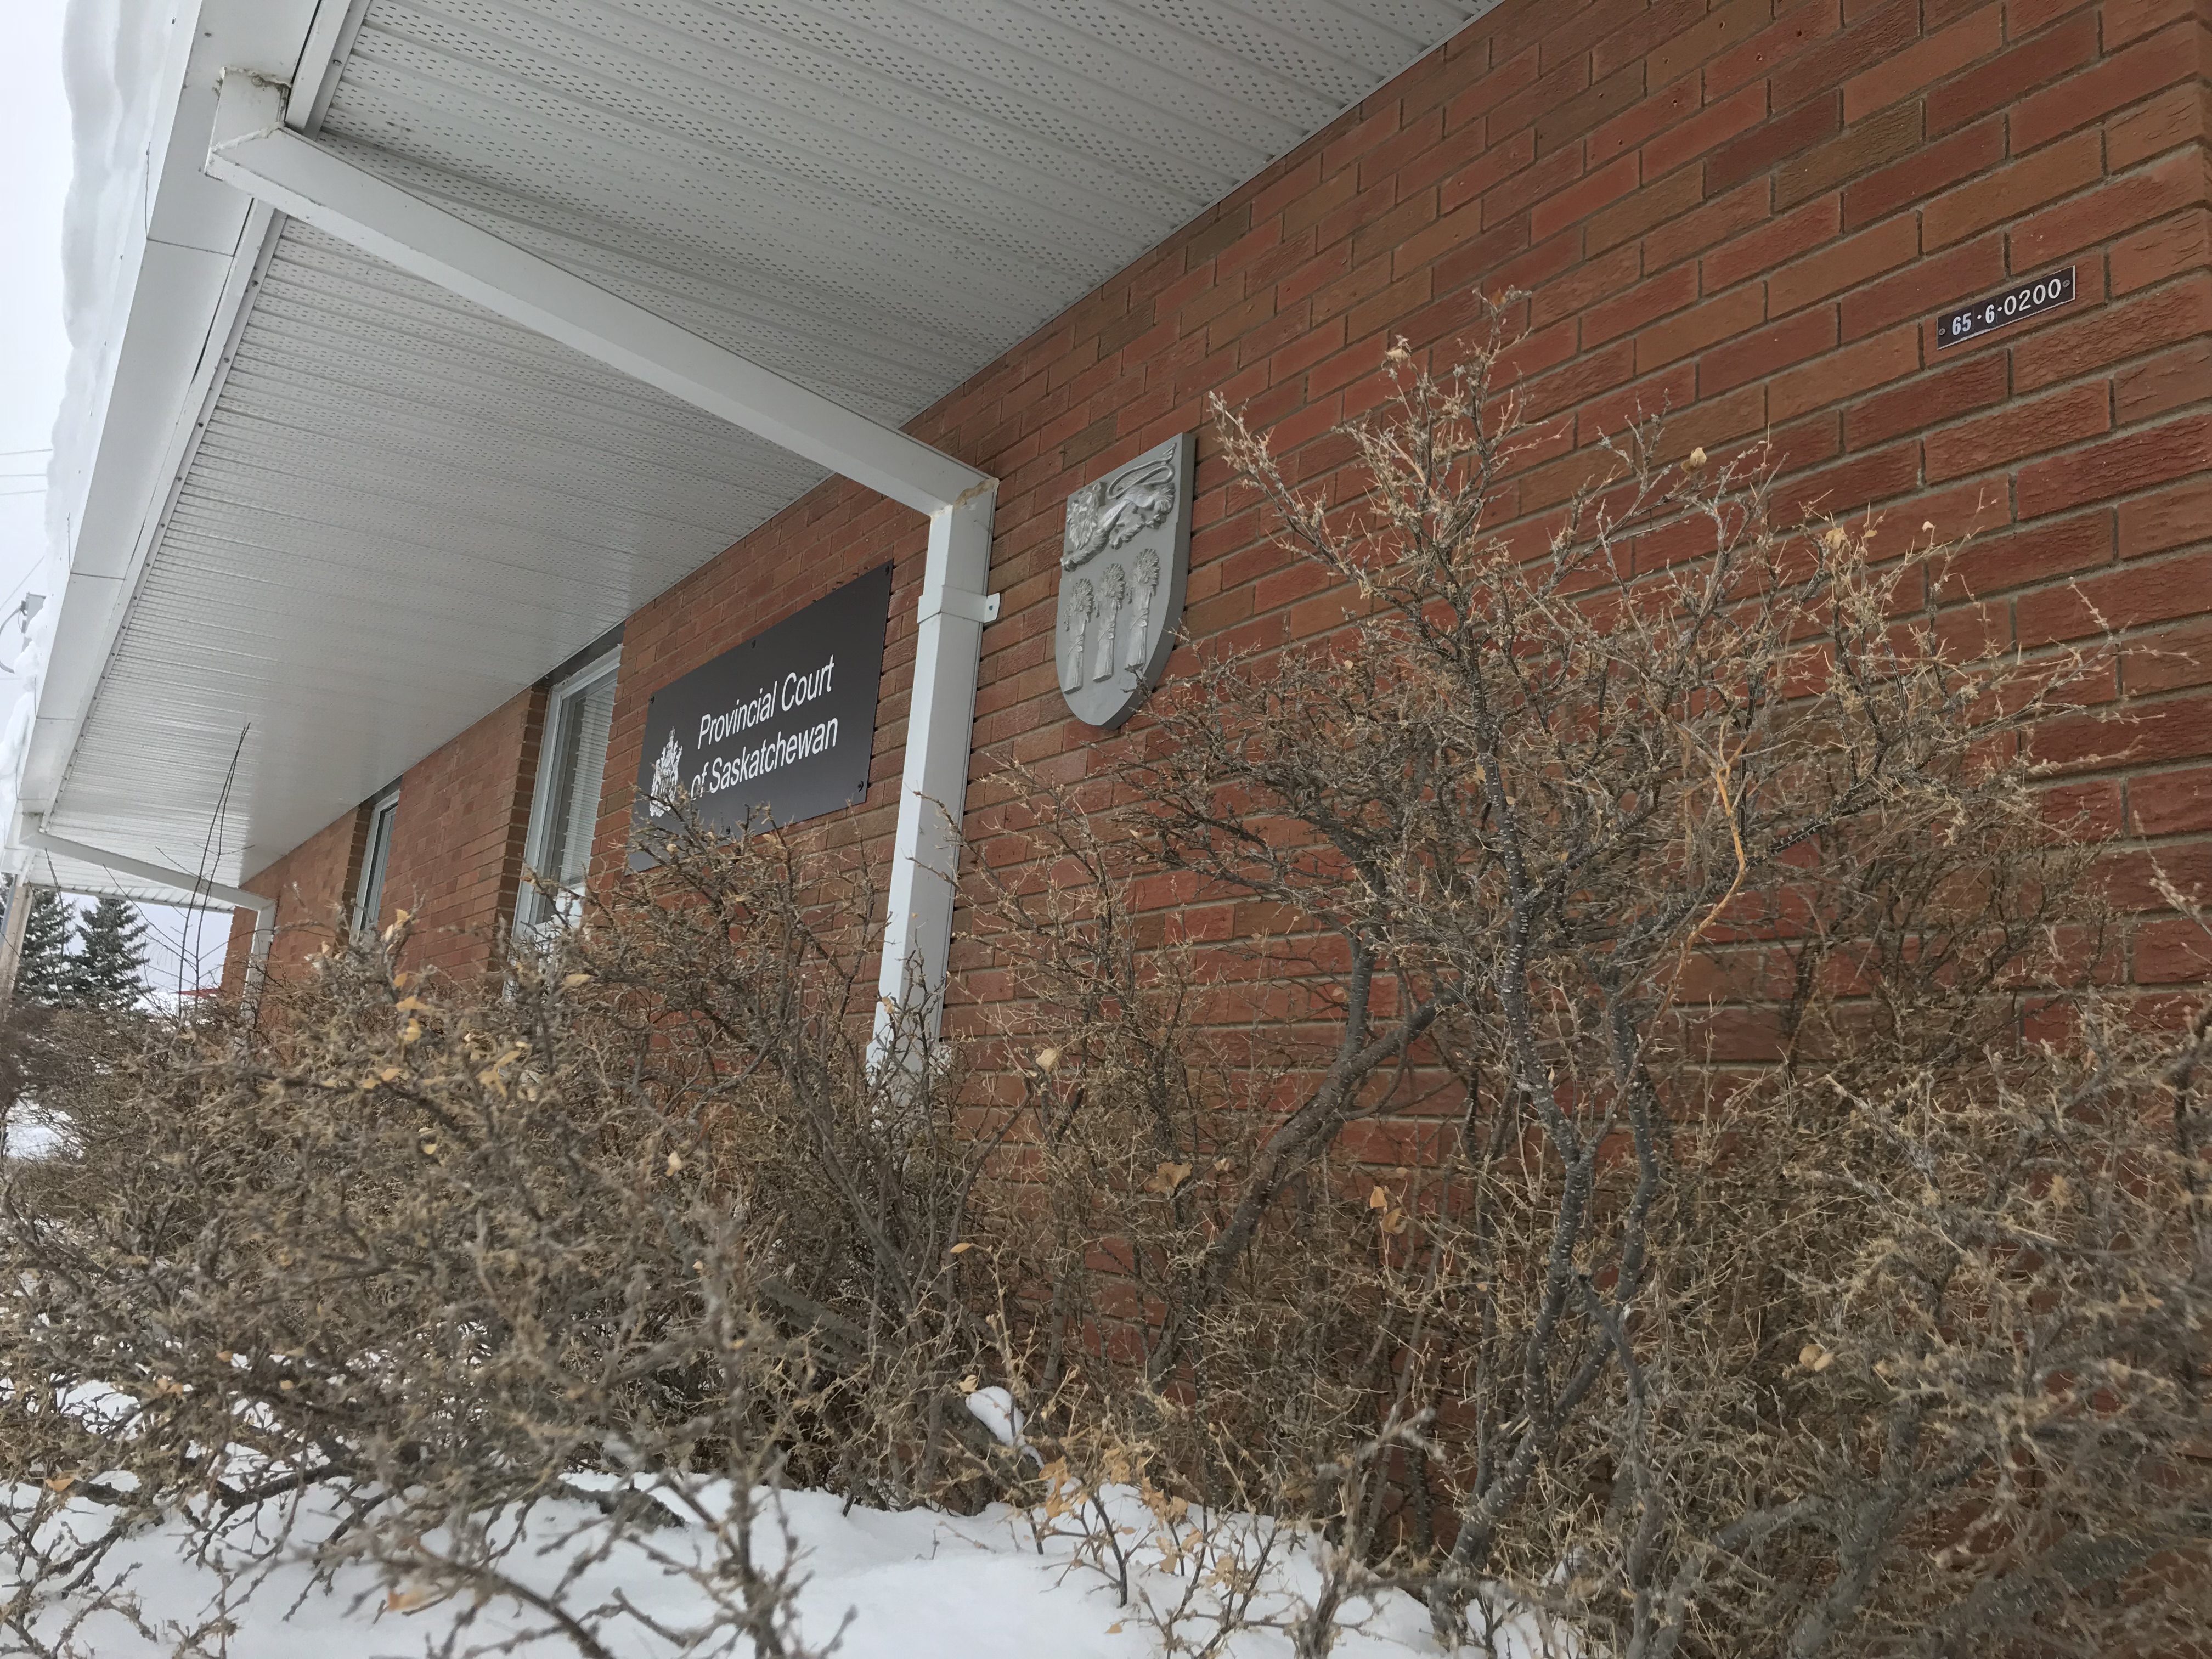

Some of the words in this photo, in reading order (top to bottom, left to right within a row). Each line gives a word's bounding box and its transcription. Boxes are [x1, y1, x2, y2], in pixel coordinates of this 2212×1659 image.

[697, 680, 777, 750] Provincial
[781, 654, 834, 712] Court
[690, 761, 709, 800] of
[710, 718, 838, 793] Saskatchewan
